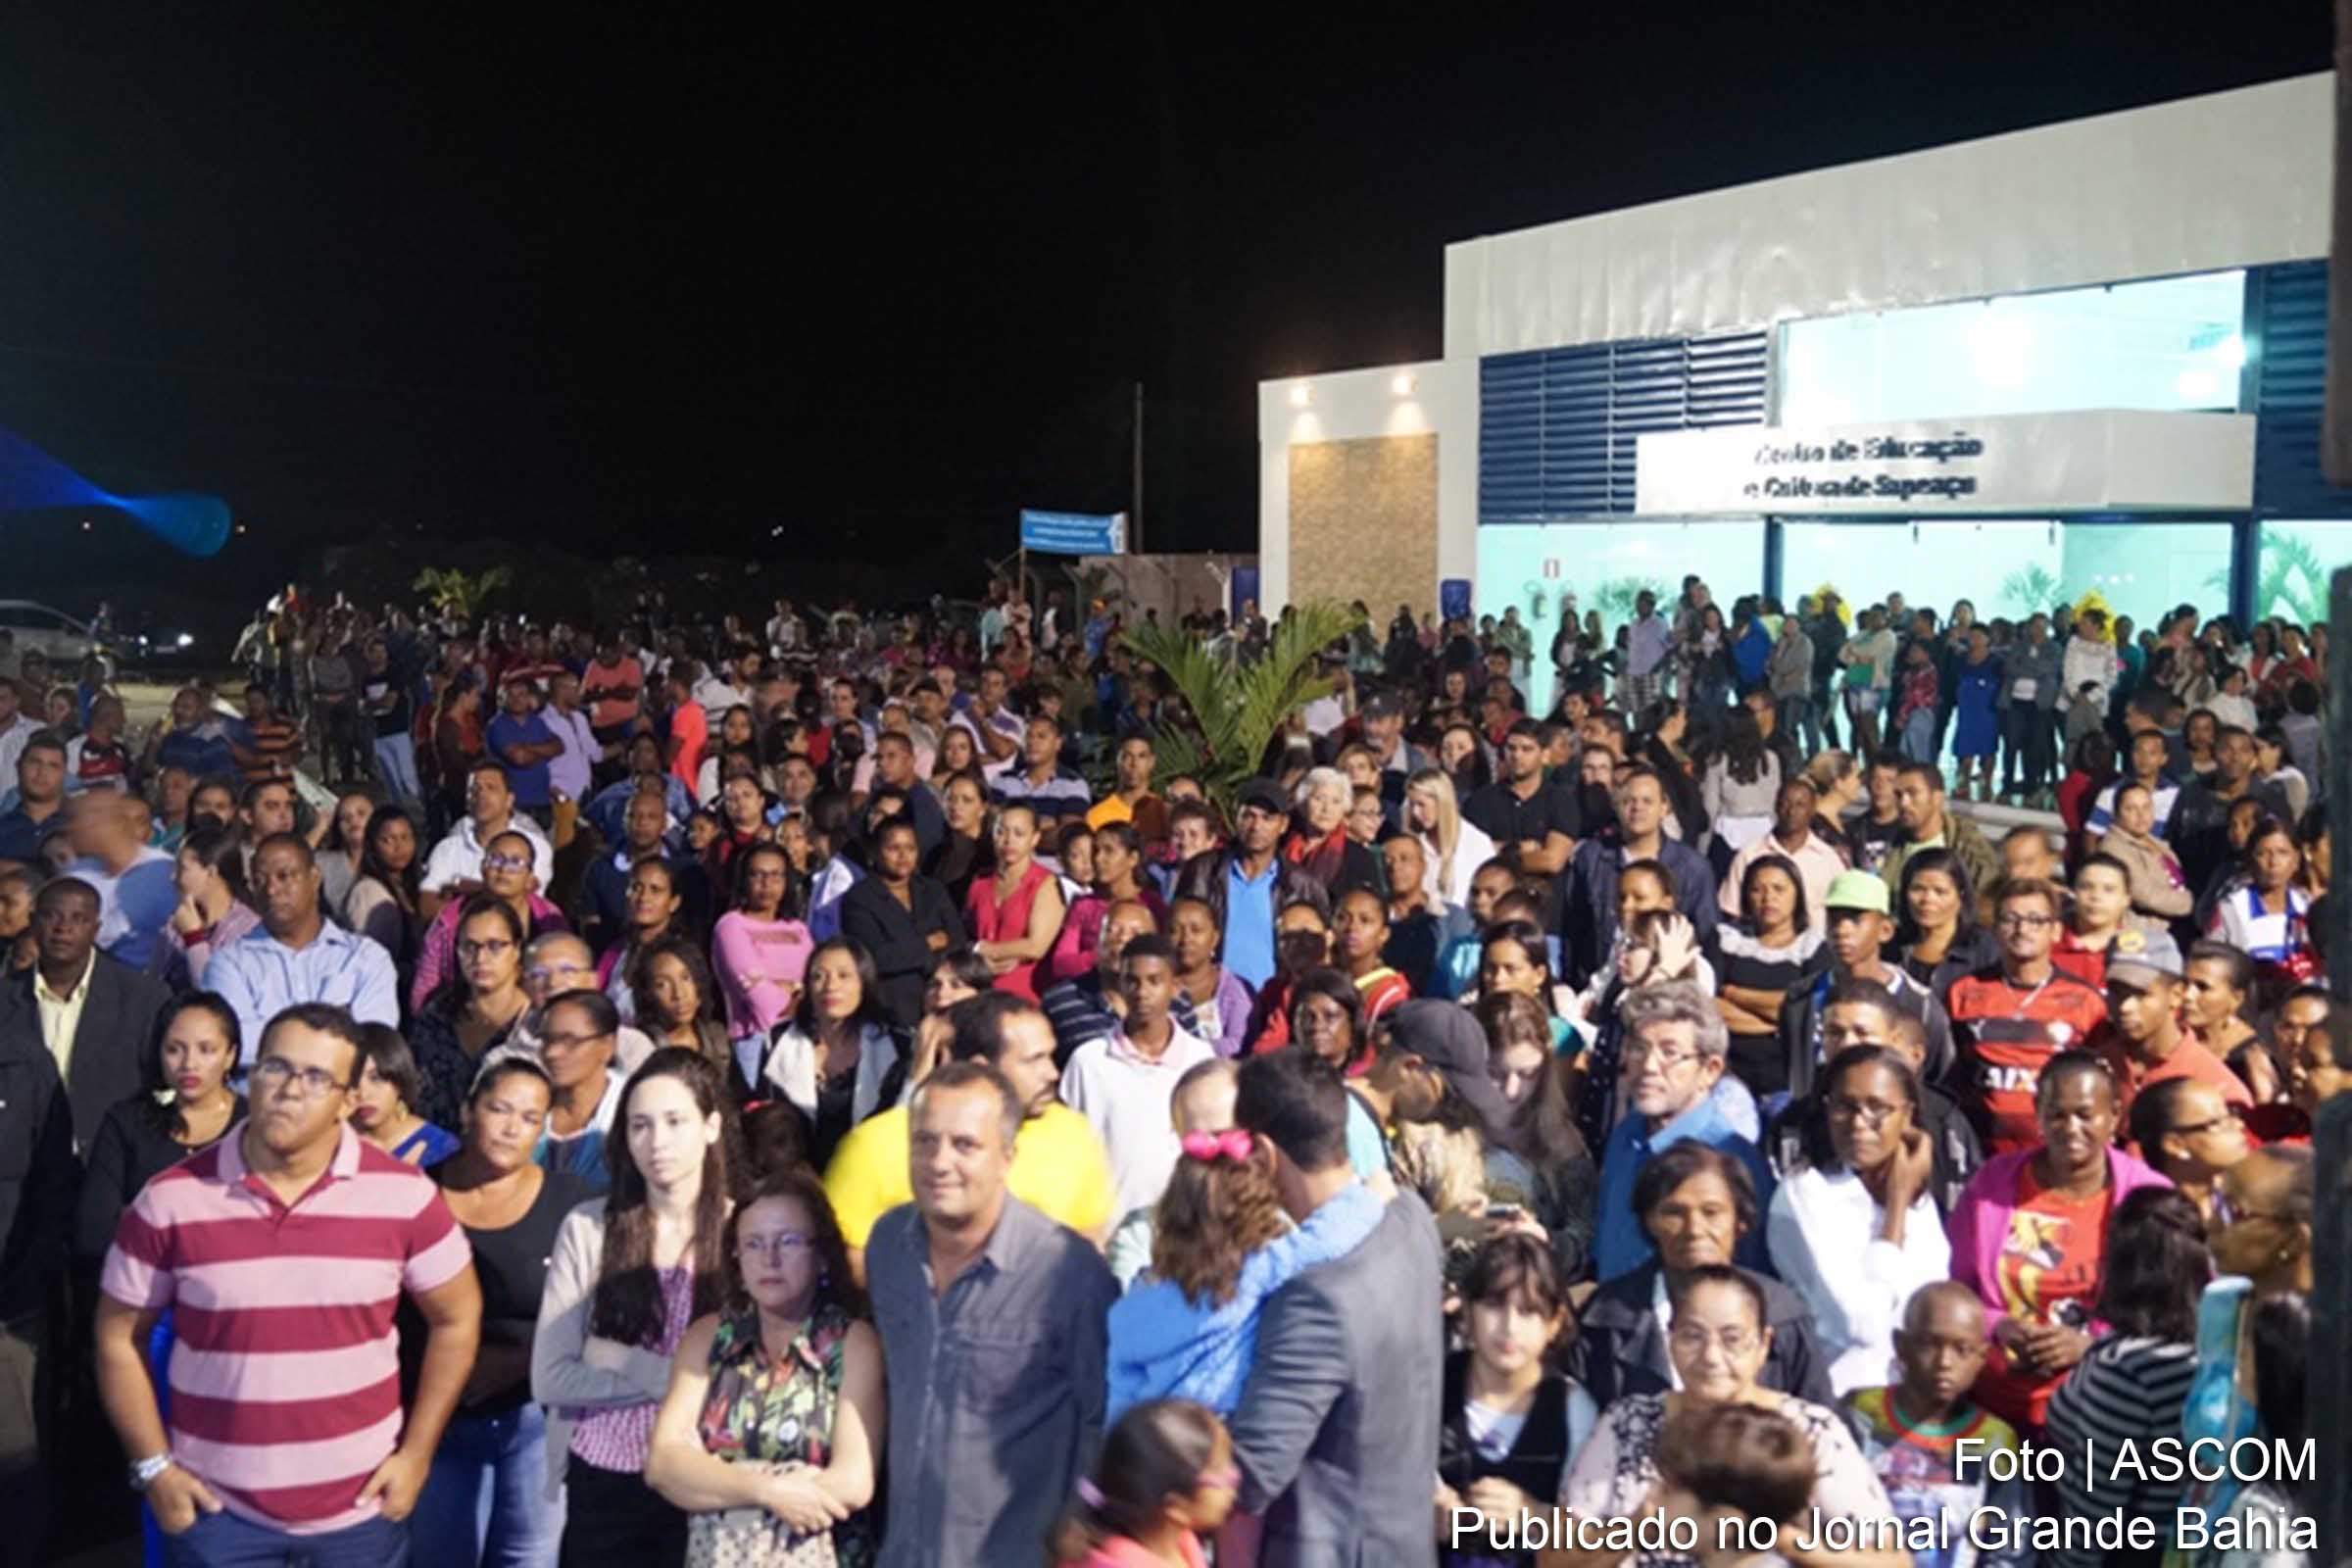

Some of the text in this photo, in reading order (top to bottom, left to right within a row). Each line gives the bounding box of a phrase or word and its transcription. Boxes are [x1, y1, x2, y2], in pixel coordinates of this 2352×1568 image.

[1830, 438, 1859, 462] de
[1863, 429, 1983, 464] Educação
[1841, 474, 1871, 496] de
